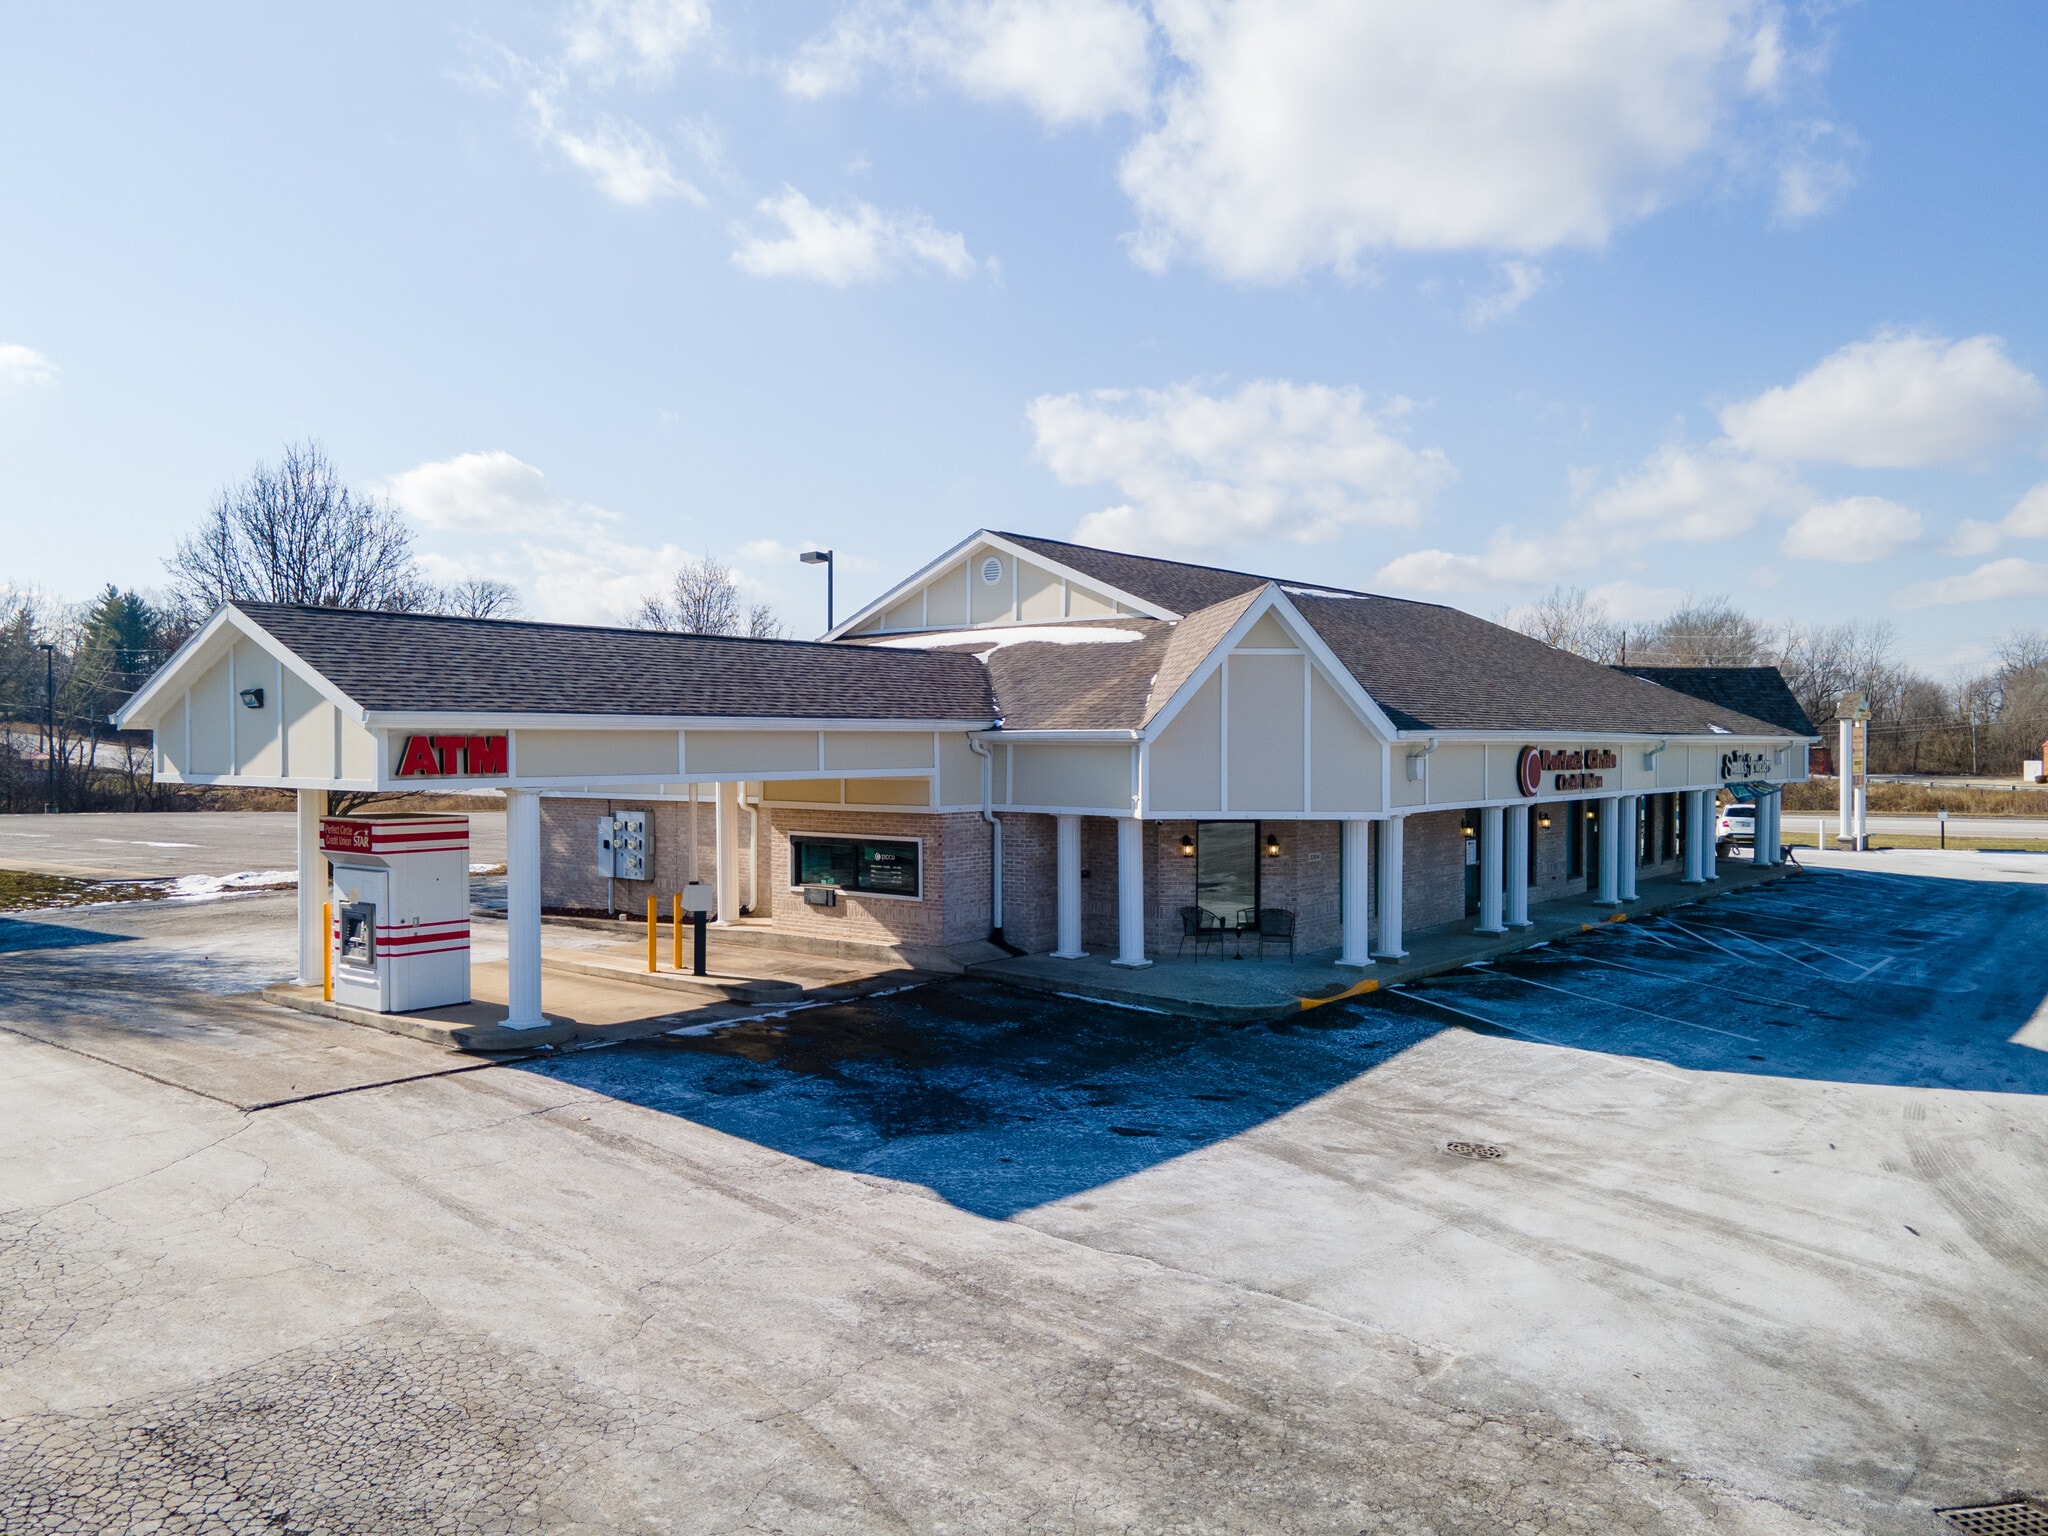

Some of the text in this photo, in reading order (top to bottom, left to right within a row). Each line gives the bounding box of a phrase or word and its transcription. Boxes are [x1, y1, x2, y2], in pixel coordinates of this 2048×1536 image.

[396, 736, 508, 775] ATM
[325, 824, 352, 835] Perfect Circle
[326, 835, 351, 846] Credit Union
[353, 835, 369, 847] STAR
